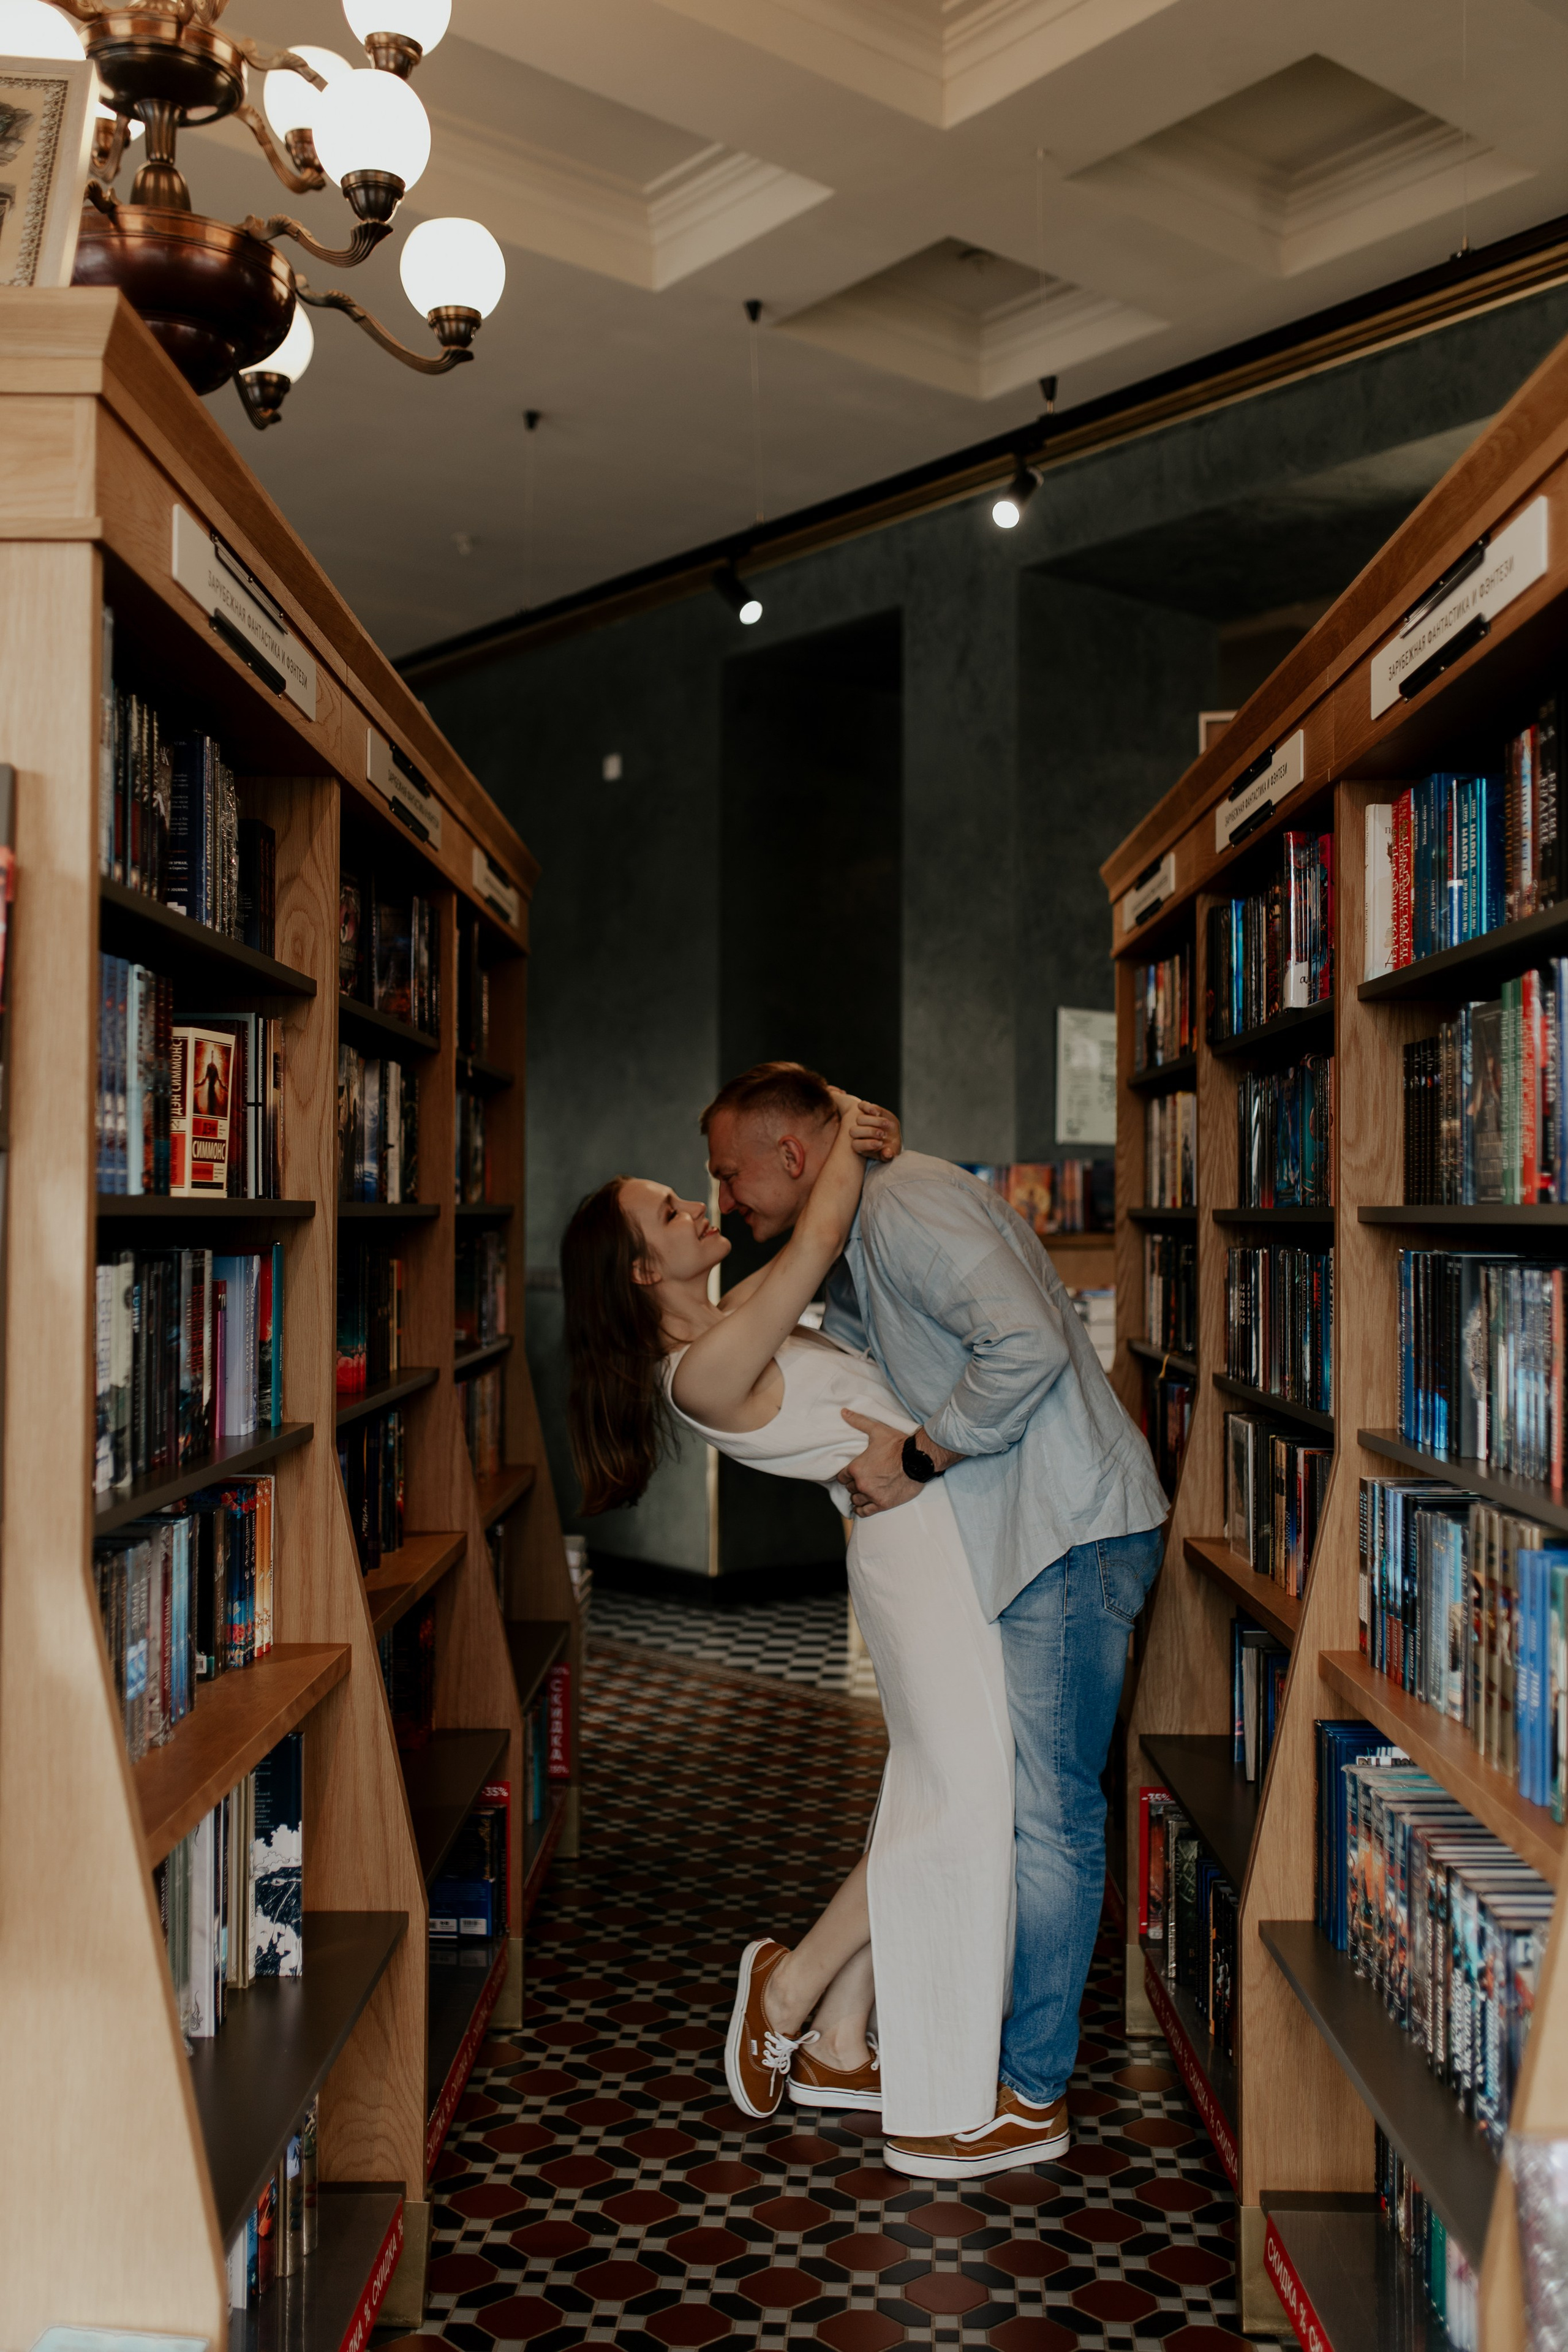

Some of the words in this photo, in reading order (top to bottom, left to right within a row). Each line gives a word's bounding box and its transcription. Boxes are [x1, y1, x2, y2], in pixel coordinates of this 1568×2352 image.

[207, 569, 246, 625] ЗАРУБЕЖНАЯ
[247, 614, 281, 662] ФАНТАСТИКА
[281, 650, 287, 664] И
[286, 657, 308, 692] ФЭНТЕЗИ
[1388, 633, 1426, 682] ЗАРУБЕЖНАЯ
[1427, 600, 1470, 644] ФАНТАСТИКА
[1471, 592, 1477, 608] И
[1479, 554, 1515, 598] ФЭНТЕЗИ
[1270, 762, 1288, 786] ФЭНТЕЗИ
[171, 1038, 183, 1091] СИММОНС
[172, 1093, 184, 1115] ДЭН
[192, 1140, 225, 1160] СИММОНС
[549, 1678, 565, 1762] СКИДКА
[481, 1786, 509, 1798] -35%
[1188, 2062, 1209, 2117] СКИДКА
[1215, 2119, 1238, 2181] СКИДКА
[371, 2239, 398, 2307] СКИДКА
[1267, 2236, 1299, 2315] СКИДКА
